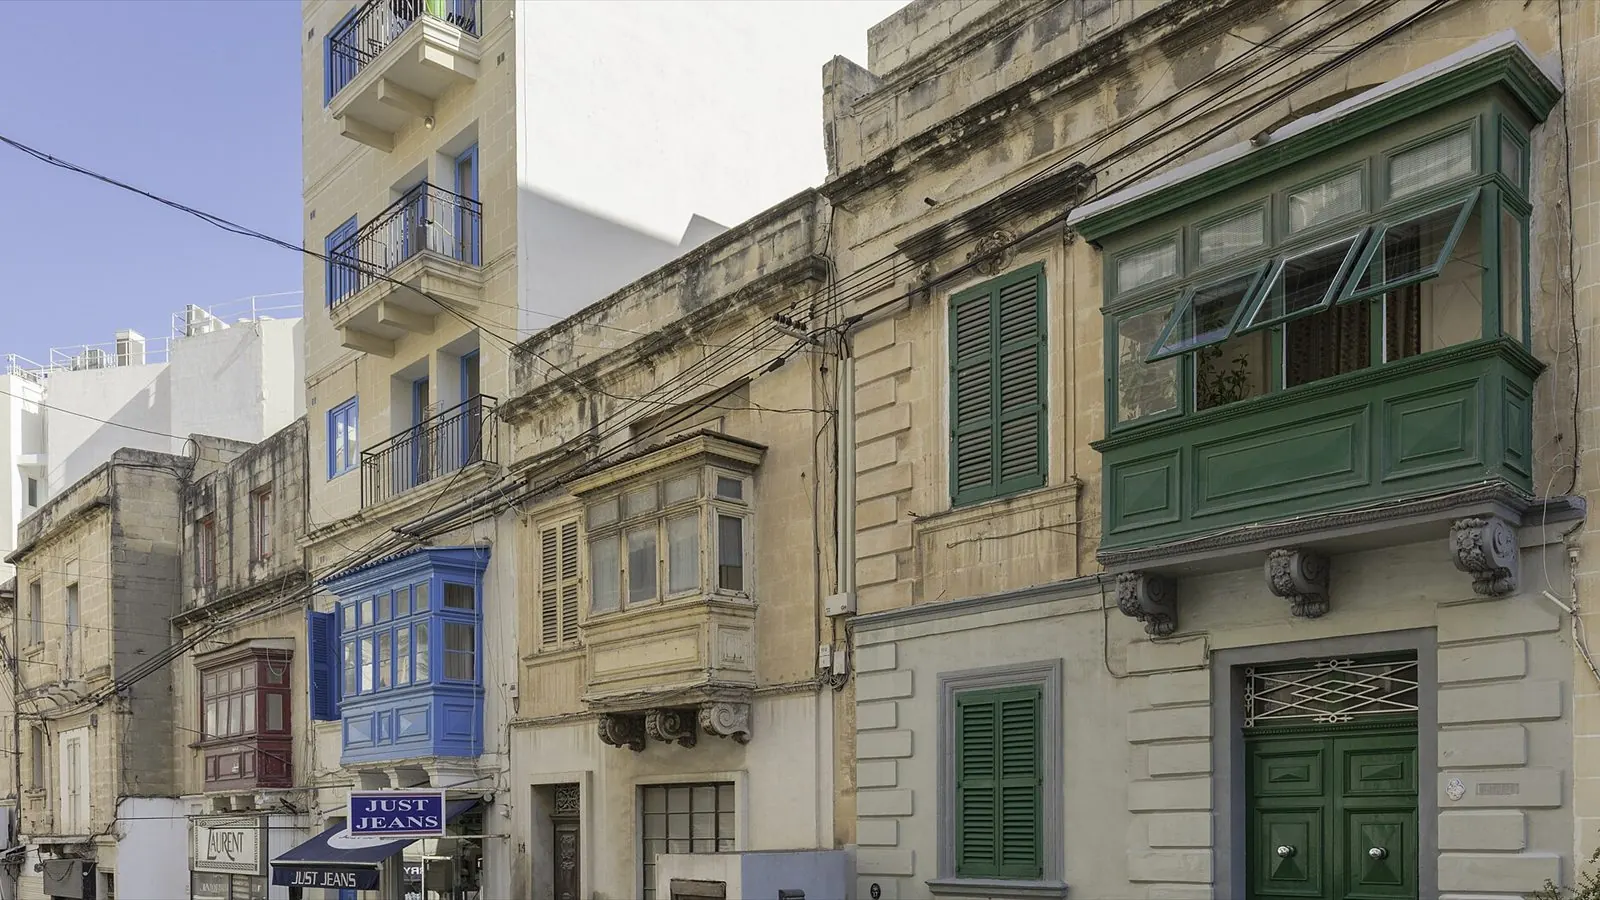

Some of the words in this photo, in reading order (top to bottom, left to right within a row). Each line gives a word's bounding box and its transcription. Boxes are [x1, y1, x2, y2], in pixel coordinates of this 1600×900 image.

[365, 799, 429, 812] JUST
[356, 815, 438, 830] JEANS
[207, 828, 244, 861] LAURENT
[291, 871, 318, 885] JUST
[320, 872, 356, 887] JEANS
